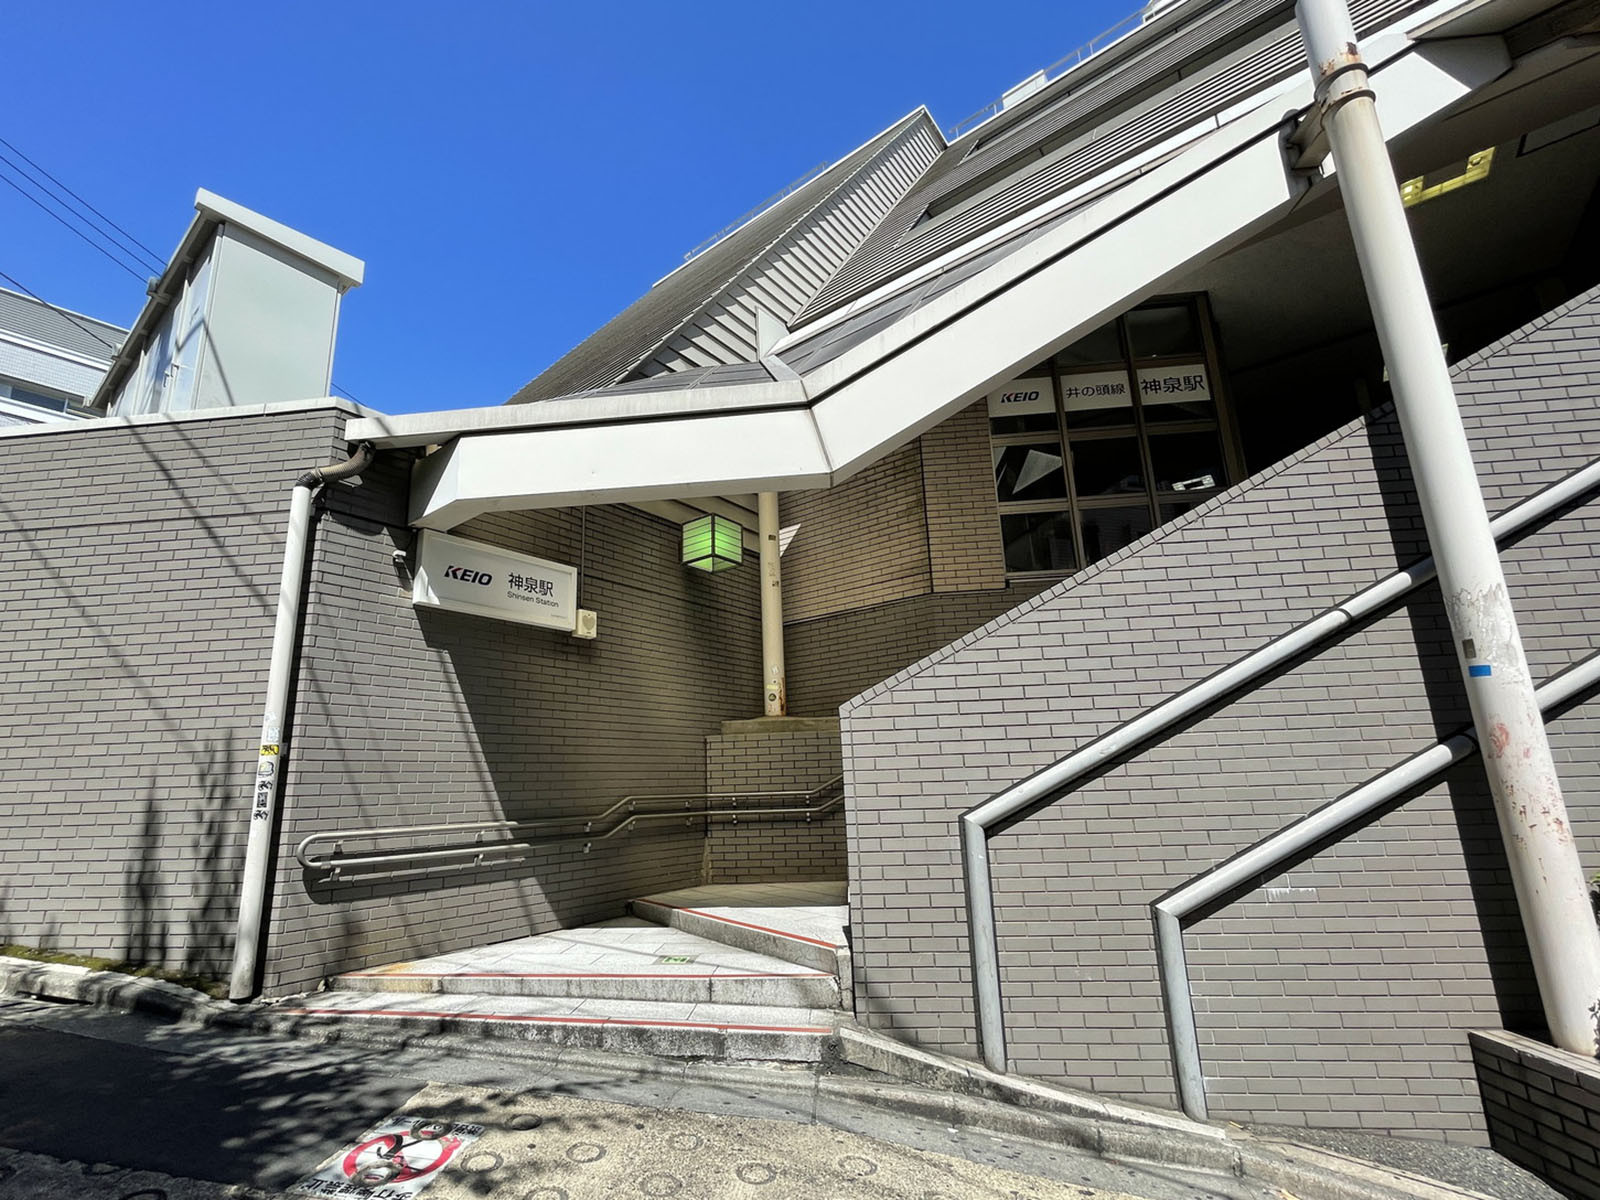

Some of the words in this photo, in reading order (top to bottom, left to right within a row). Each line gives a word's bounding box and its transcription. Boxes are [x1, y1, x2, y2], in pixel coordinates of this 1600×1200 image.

[1001, 391, 1039, 404] KEIO
[1066, 383, 1126, 399] 井の頭線
[1140, 375, 1206, 395] 神泉駅
[444, 565, 493, 586] KEIO
[508, 572, 554, 597] 神泉駅
[507, 590, 535, 603] Shinsen
[536, 596, 559, 608] Station
